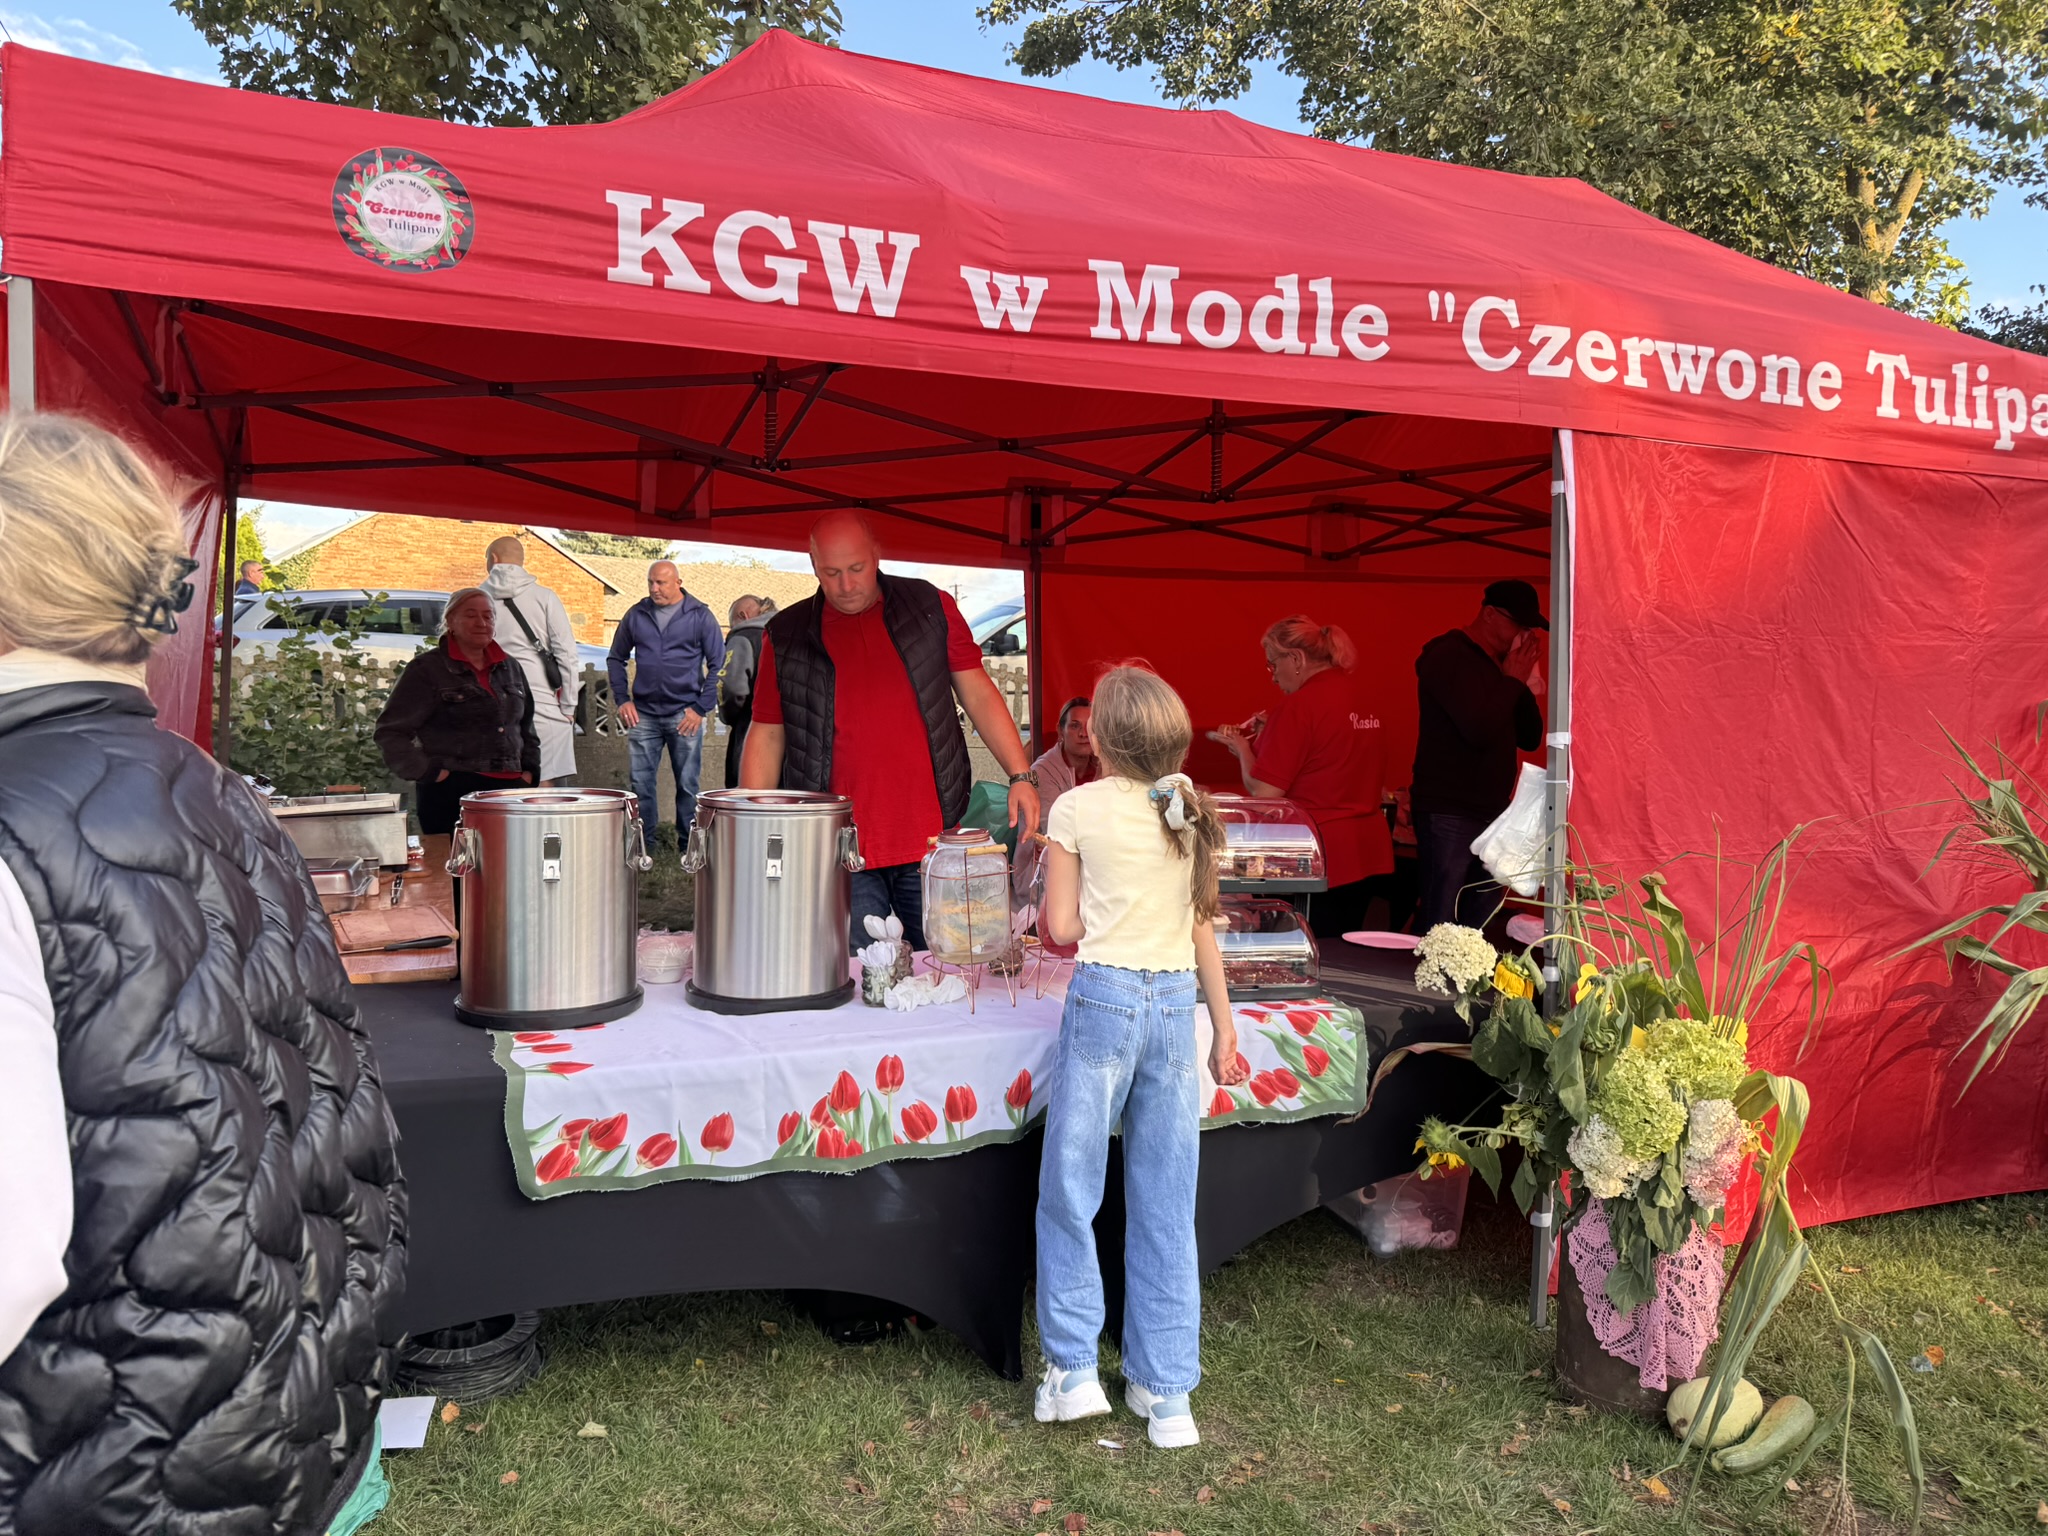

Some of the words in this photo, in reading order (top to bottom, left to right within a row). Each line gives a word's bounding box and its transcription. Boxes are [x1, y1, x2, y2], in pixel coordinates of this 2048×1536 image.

[374, 178, 395, 192] KGW
[408, 180, 432, 198] Modle
[365, 200, 442, 222] Czerwone
[386, 218, 442, 237] Tulipany
[605, 189, 921, 318] KGW
[960, 265, 1049, 333] w
[1087, 258, 1391, 361] Modle
[1428, 290, 1843, 412] "Czerwone
[1349, 712, 1380, 730] Kasia
